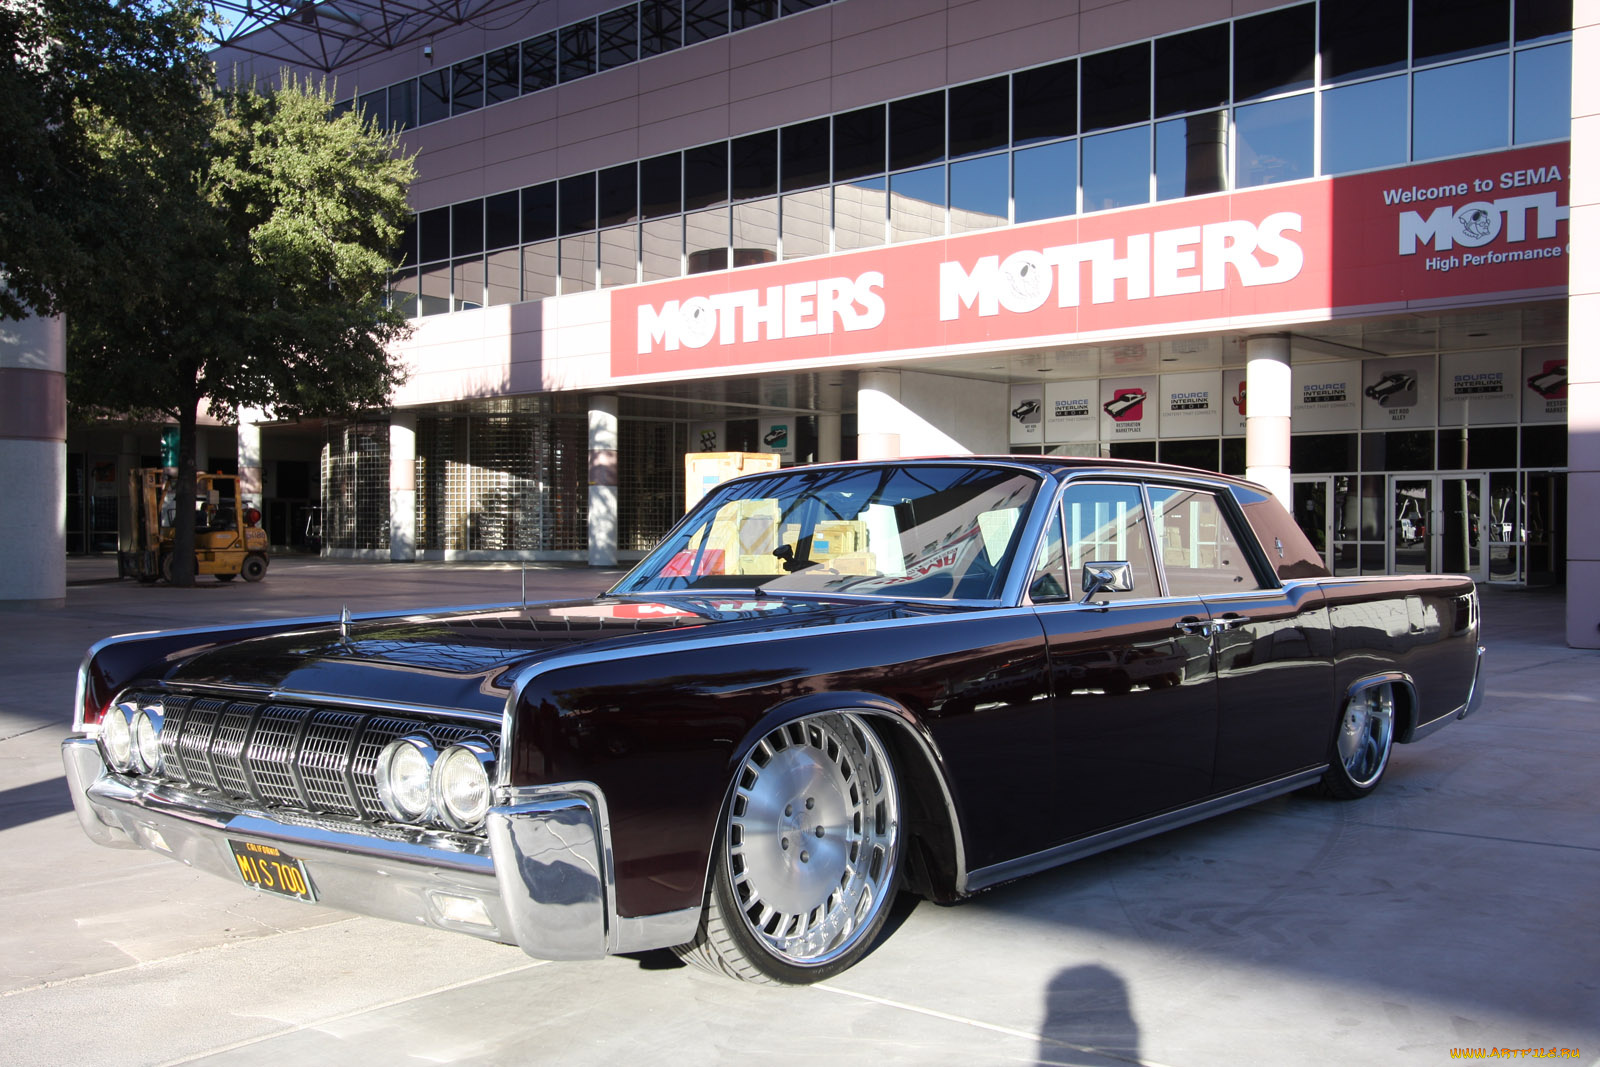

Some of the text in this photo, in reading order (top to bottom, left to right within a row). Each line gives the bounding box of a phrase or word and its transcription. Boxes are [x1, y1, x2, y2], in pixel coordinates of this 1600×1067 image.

[1383, 182, 1468, 205] Welcome
[1473, 178, 1494, 193] to
[1500, 165, 1562, 189] SEMA
[939, 211, 1304, 321] MOTHERS
[1425, 253, 1460, 271] High
[1462, 246, 1562, 267] Performance
[637, 271, 886, 354] MOTHERS
[1304, 383, 1346, 391] SOURCE
[1454, 372, 1503, 381] SOURCE
[236, 854, 307, 895] MIS 700
